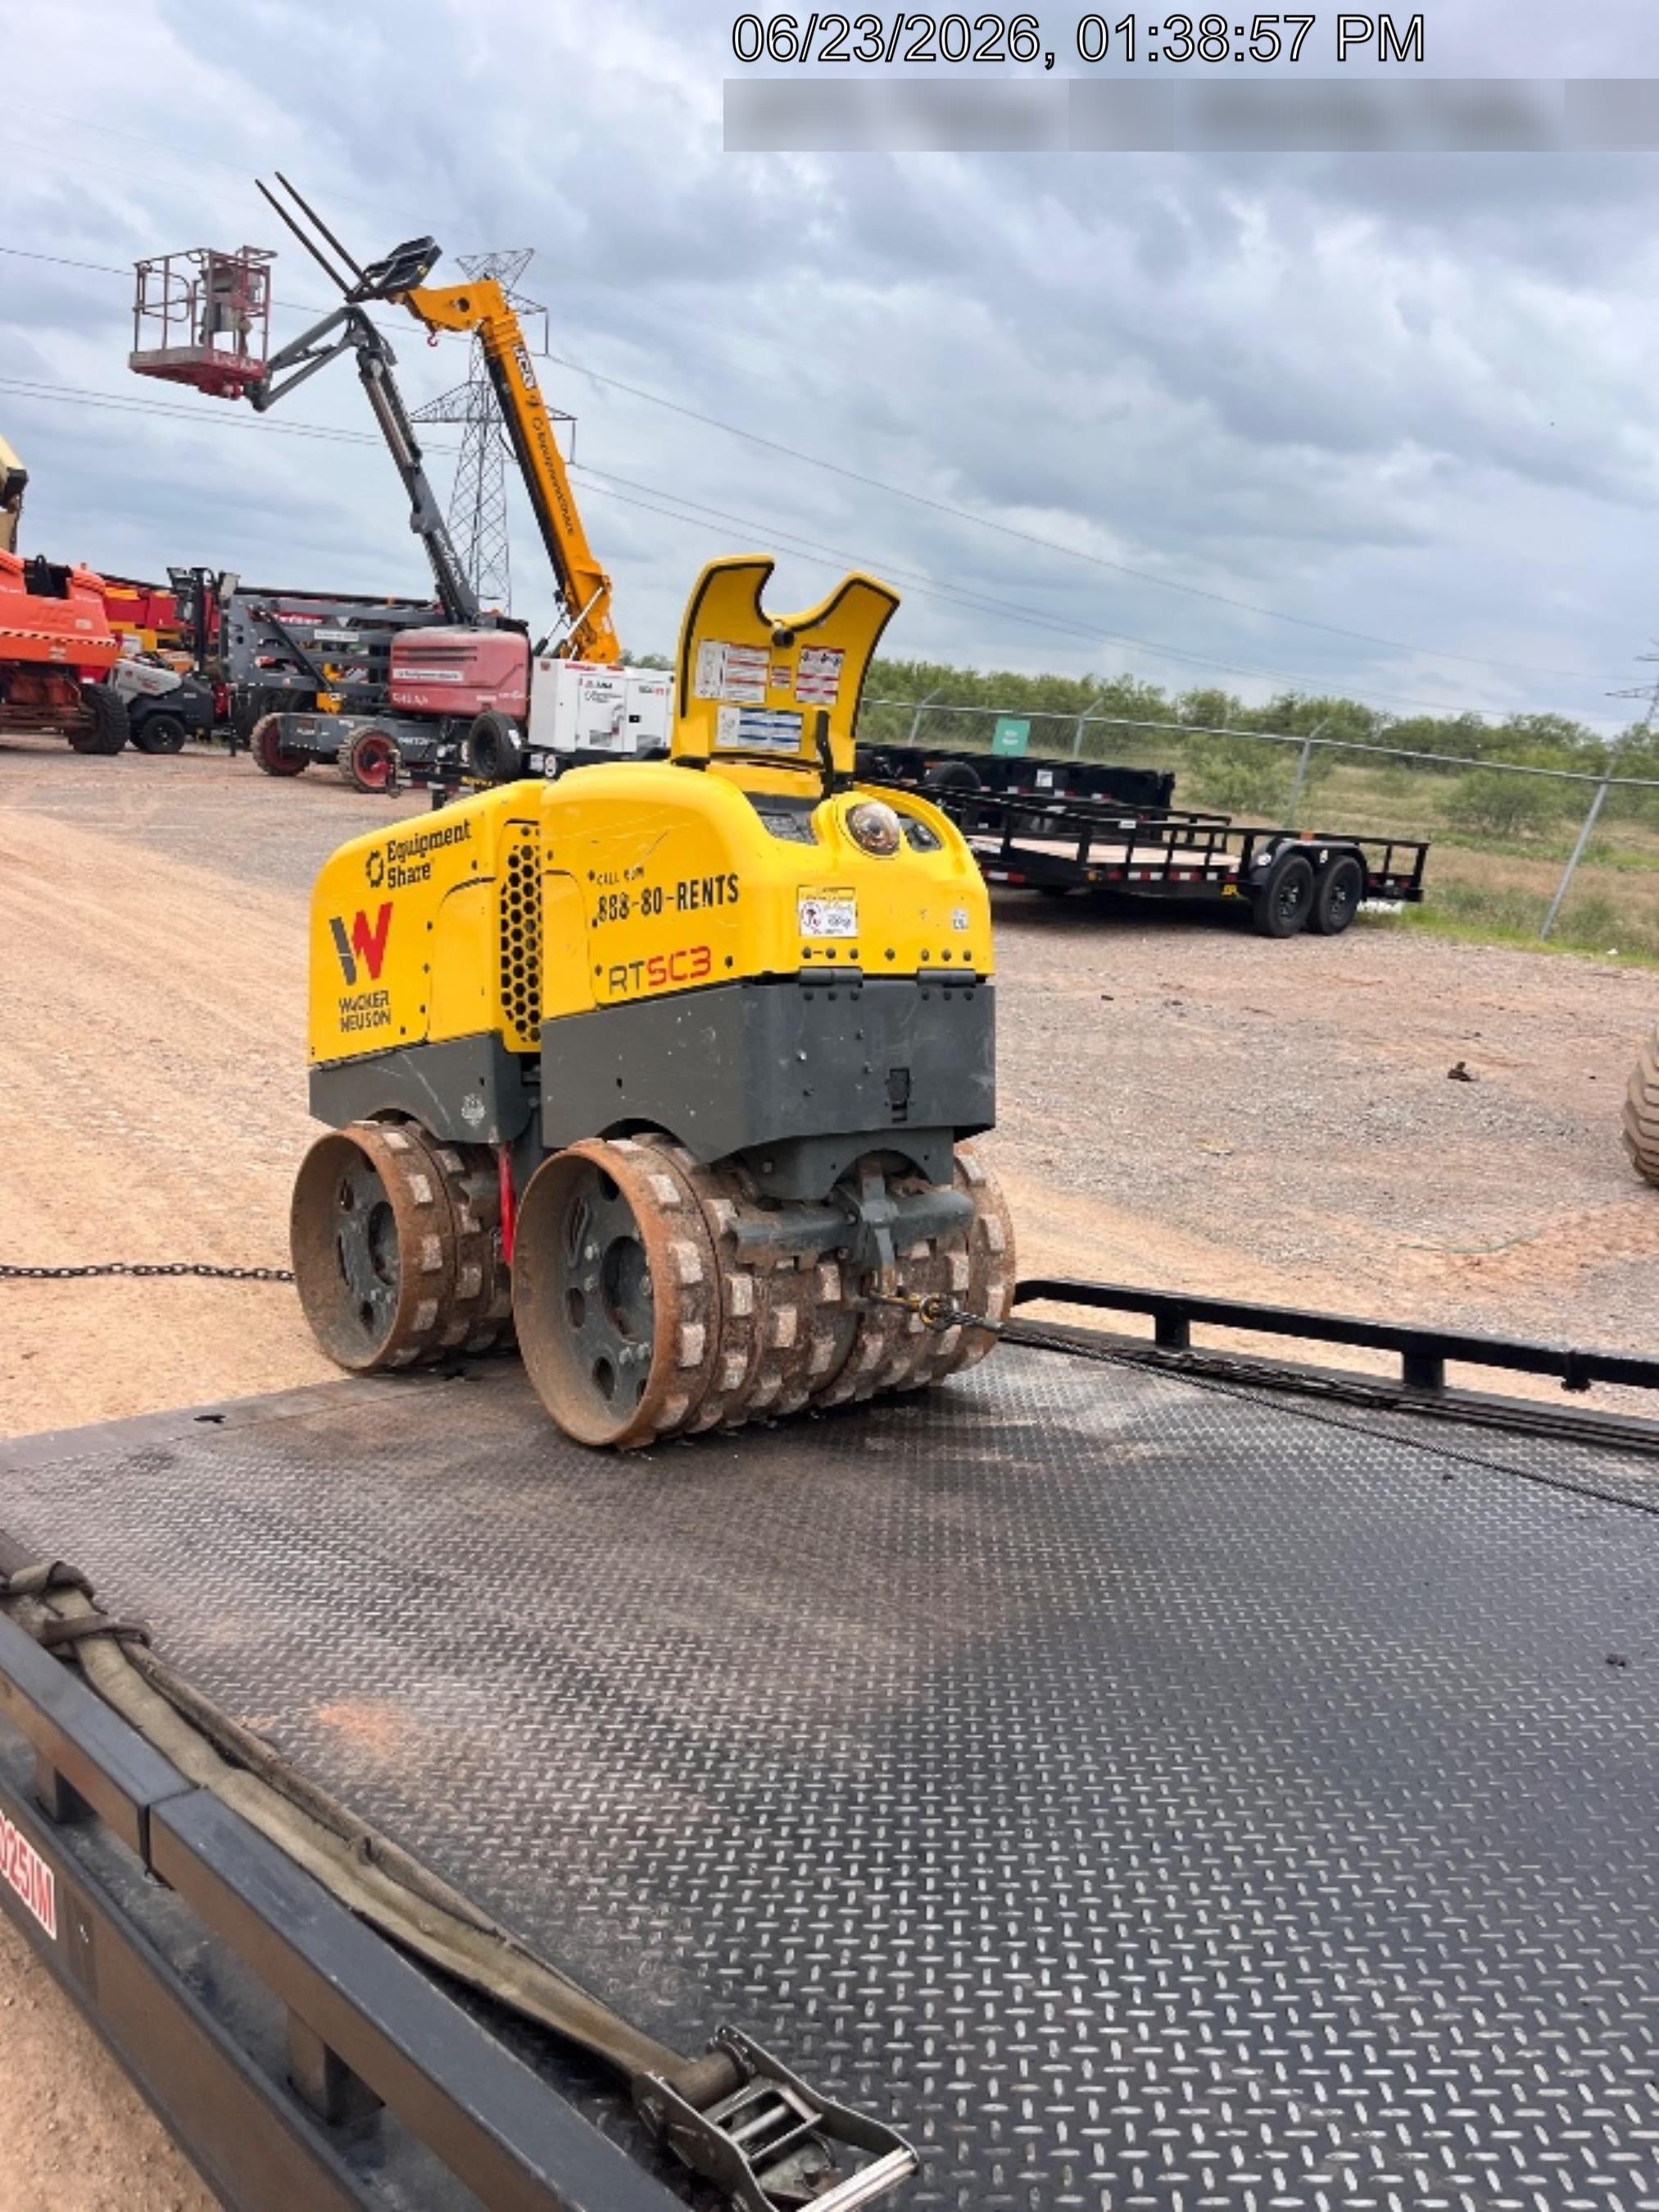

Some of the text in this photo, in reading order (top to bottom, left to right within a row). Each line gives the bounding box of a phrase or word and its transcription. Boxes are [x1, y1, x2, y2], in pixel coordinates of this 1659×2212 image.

[386, 818, 472, 863] Equipment
[387, 863, 432, 889] Share
[598, 873, 739, 922] 888-80-RENTS
[609, 945, 712, 995] RTSC3
[338, 990, 390, 1015] WACKER
[340, 1009, 392, 1033] NEUSON
